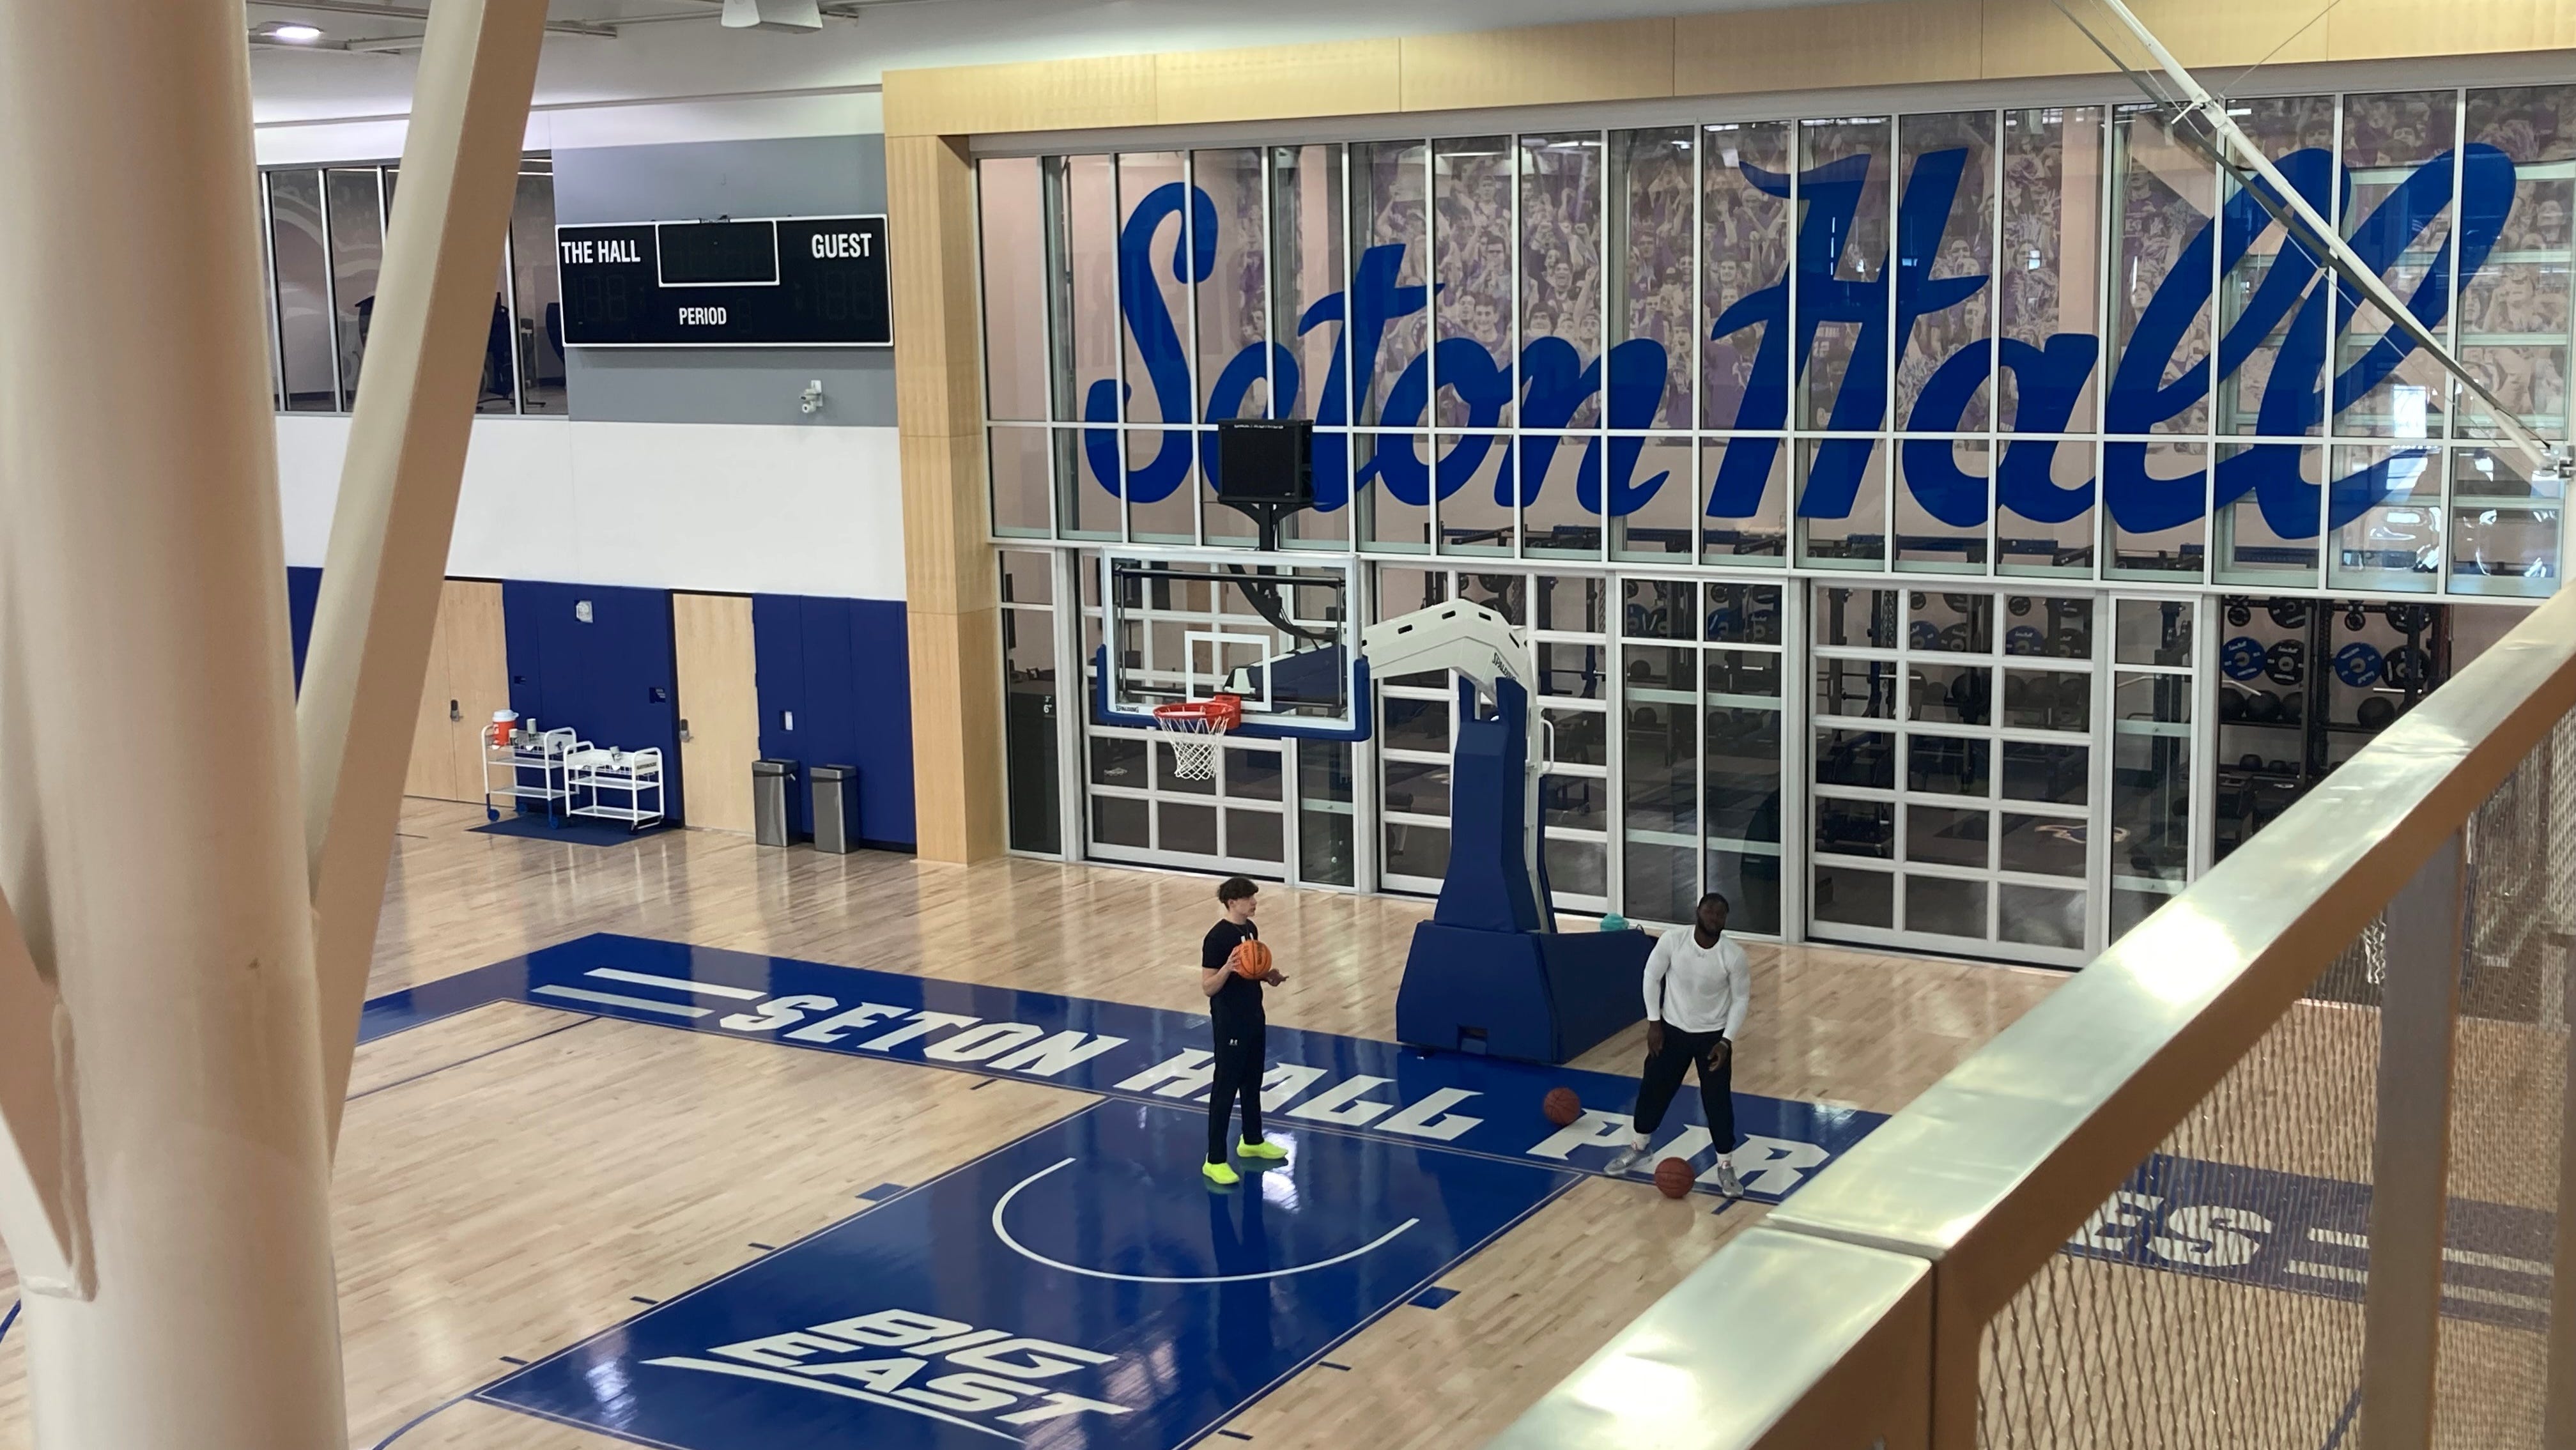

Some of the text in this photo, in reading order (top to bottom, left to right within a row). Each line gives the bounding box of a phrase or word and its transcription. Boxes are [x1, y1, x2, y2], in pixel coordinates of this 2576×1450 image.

[561, 239, 641, 265] THE HALL
[812, 233, 872, 259] GUEST
[679, 307, 727, 326] PERIOD
[1084, 142, 2517, 541] Seton Hall
[720, 994, 1130, 1077] SETON
[1113, 1047, 1483, 1141] HALL
[707, 1331, 1134, 1424] EAST
[806, 1309, 1119, 1378] BIG
